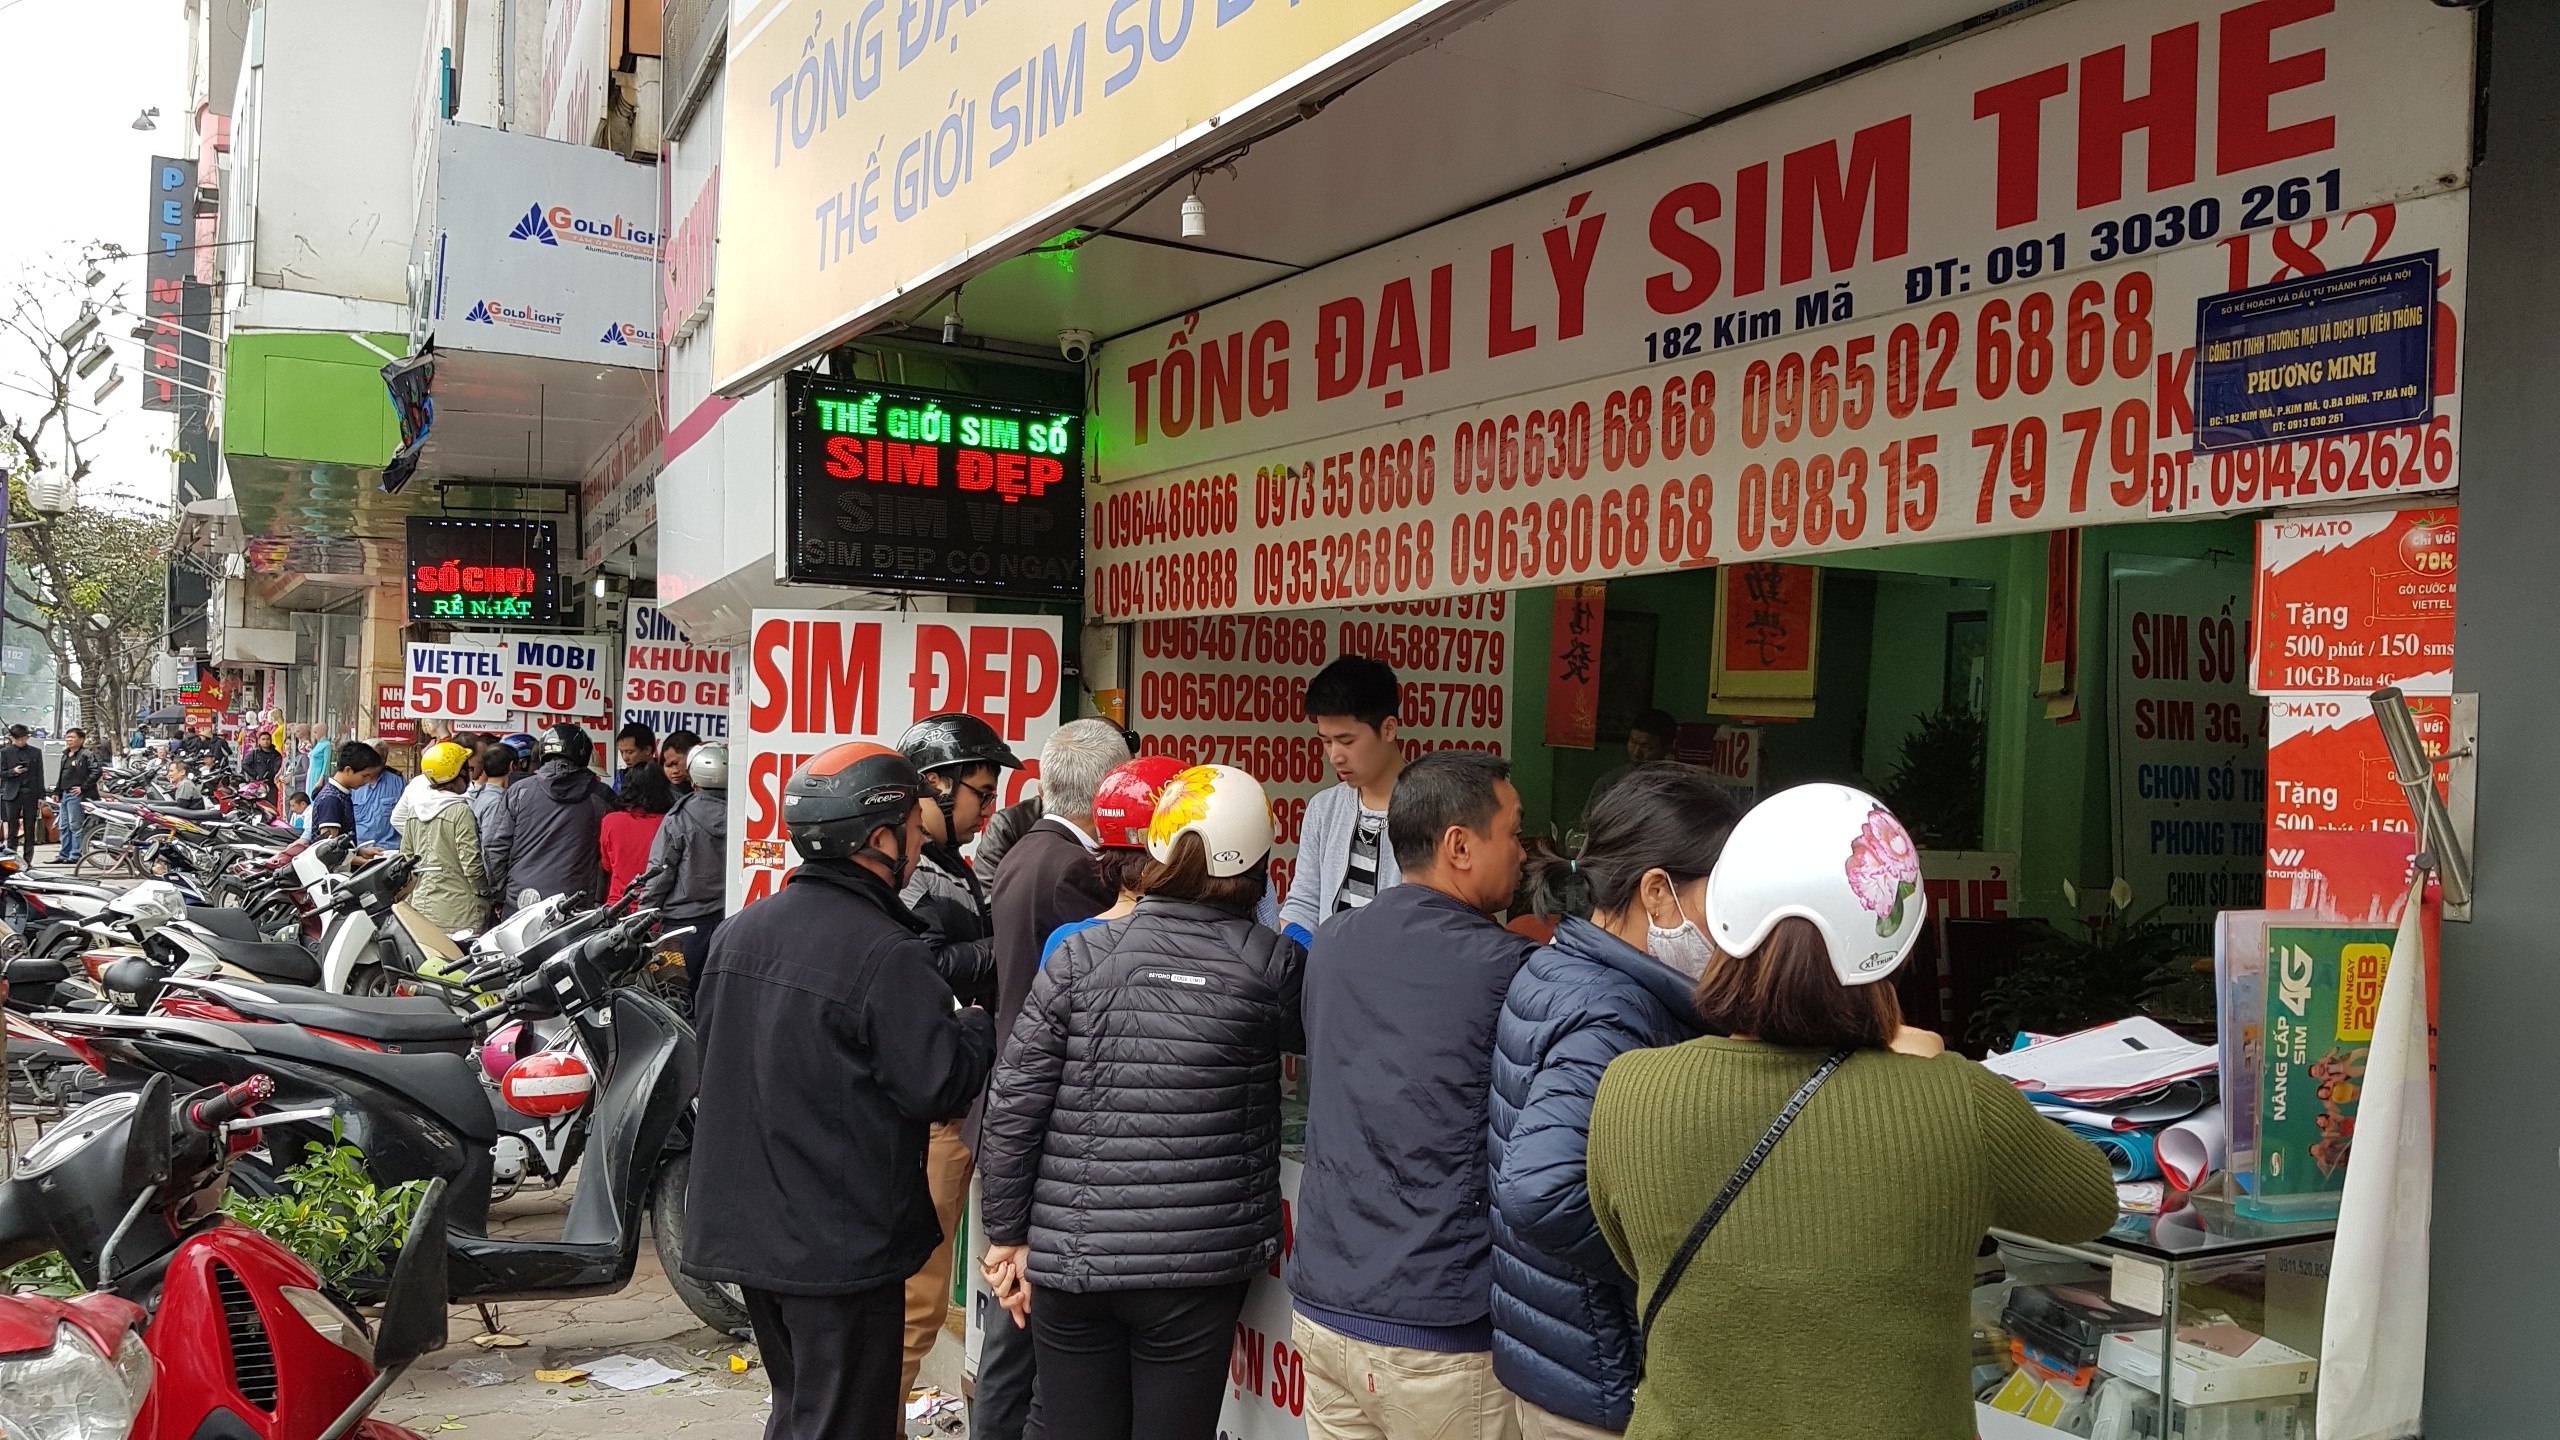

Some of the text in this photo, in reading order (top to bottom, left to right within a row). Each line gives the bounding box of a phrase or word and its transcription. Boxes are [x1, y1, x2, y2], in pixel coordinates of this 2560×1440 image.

[770, 9, 884, 169] TỔNG
[815, 134, 885, 272] THẾ
[893, 89, 976, 222] GIỚI
[989, 21, 1087, 169] SIM
[160, 167, 185, 257] PET
[585, 245, 619, 256] Aluminium
[620, 251, 653, 263] Composite
[1645, 167, 2341, 363] 182 Kim Mã ĐT: 091 3030 261
[1128, 311, 1290, 446] TỔNG
[1314, 263, 1453, 409] ĐẠI
[1487, 192, 1606, 359] LÝ
[1645, 114, 1912, 315] SIM
[2358, 273, 2378, 287] PHỐ
[2394, 269, 2411, 280] NỘI
[152, 278, 182, 402] MART
[2208, 304, 2423, 362] CÔNG TY TNHH THƯƠNG MẠI VÀ DỊCH VỤ VIỄN THÔNG
[2247, 351, 2377, 394] PHƯƠNG MINH
[815, 394, 1070, 455] THẾ GIỚI SIM SỐ
[2225, 413, 2240, 424] 182
[2241, 410, 2258, 422] KIM
[2277, 404, 2302, 417] P.KIM
[2323, 396, 2344, 410] Q.BA
[2372, 387, 2398, 401] TP.HÀ
[2400, 384, 2417, 398] NỘI
[2287, 418, 2308, 430] 0913
[2310, 415, 2327, 427] 030
[2328, 413, 2344, 424] 261
[824, 436, 1065, 503] SIM ĐẸP
[2210, 414, 2454, 508] 0914262626
[836, 491, 1055, 546] SIM VIP
[1108, 473, 1238, 549] 0964486666
[416, 559, 461, 592] SỐ
[805, 538, 1078, 582] SIM ĐẸP CÓ NGAY
[1109, 547, 1238, 618] 0941368888
[2398, 583, 2416, 595] GÓI
[2418, 580, 2447, 594] CƯỚC
[433, 593, 532, 616] RẺ NHẤT
[636, 606, 676, 642] SIM
[2285, 602, 2349, 630] Tặng
[2412, 599, 2453, 610] VIETTEL
[517, 641, 596, 671] MOBI
[1142, 615, 1327, 667] 0964676868
[1339, 620, 1505, 675] 0945887979
[2131, 595, 2236, 684] SIM SỐ
[2284, 633, 2455, 660] 500 phút 150 sms
[413, 648, 504, 677] VIETTEL
[749, 618, 881, 735] SIM
[2284, 666, 2396, 686] 10GB Data 4G
[410, 675, 504, 715] 50%
[511, 670, 602, 712] 50%
[626, 677, 687, 705] 360
[1140, 670, 1319, 724] 096502686
[2269, 702, 2341, 718] OMATO
[397, 722, 415, 732] ANH
[624, 708, 661, 734] SIM
[2135, 698, 2249, 749] SIM 3G,
[2424, 719, 2444, 733] với
[2138, 754, 2234, 807] CHỌN SỐ
[2274, 781, 2338, 811] Tặng
[1101, 808, 1125, 818] YAMAHA
[2150, 820, 2225, 856] PHONG
[1148, 972, 1171, 980] BEYOND
[2279, 943, 2314, 1017] 4G
[2343, 958, 2356, 1030] NHẬN NGAY
[2354, 955, 2378, 1030] 2GB
[2294, 1026, 2307, 1065] SIM
[2272, 1016, 2290, 1121] NÂNG CẤP
[1228, 1320, 1265, 1400] ỌN
